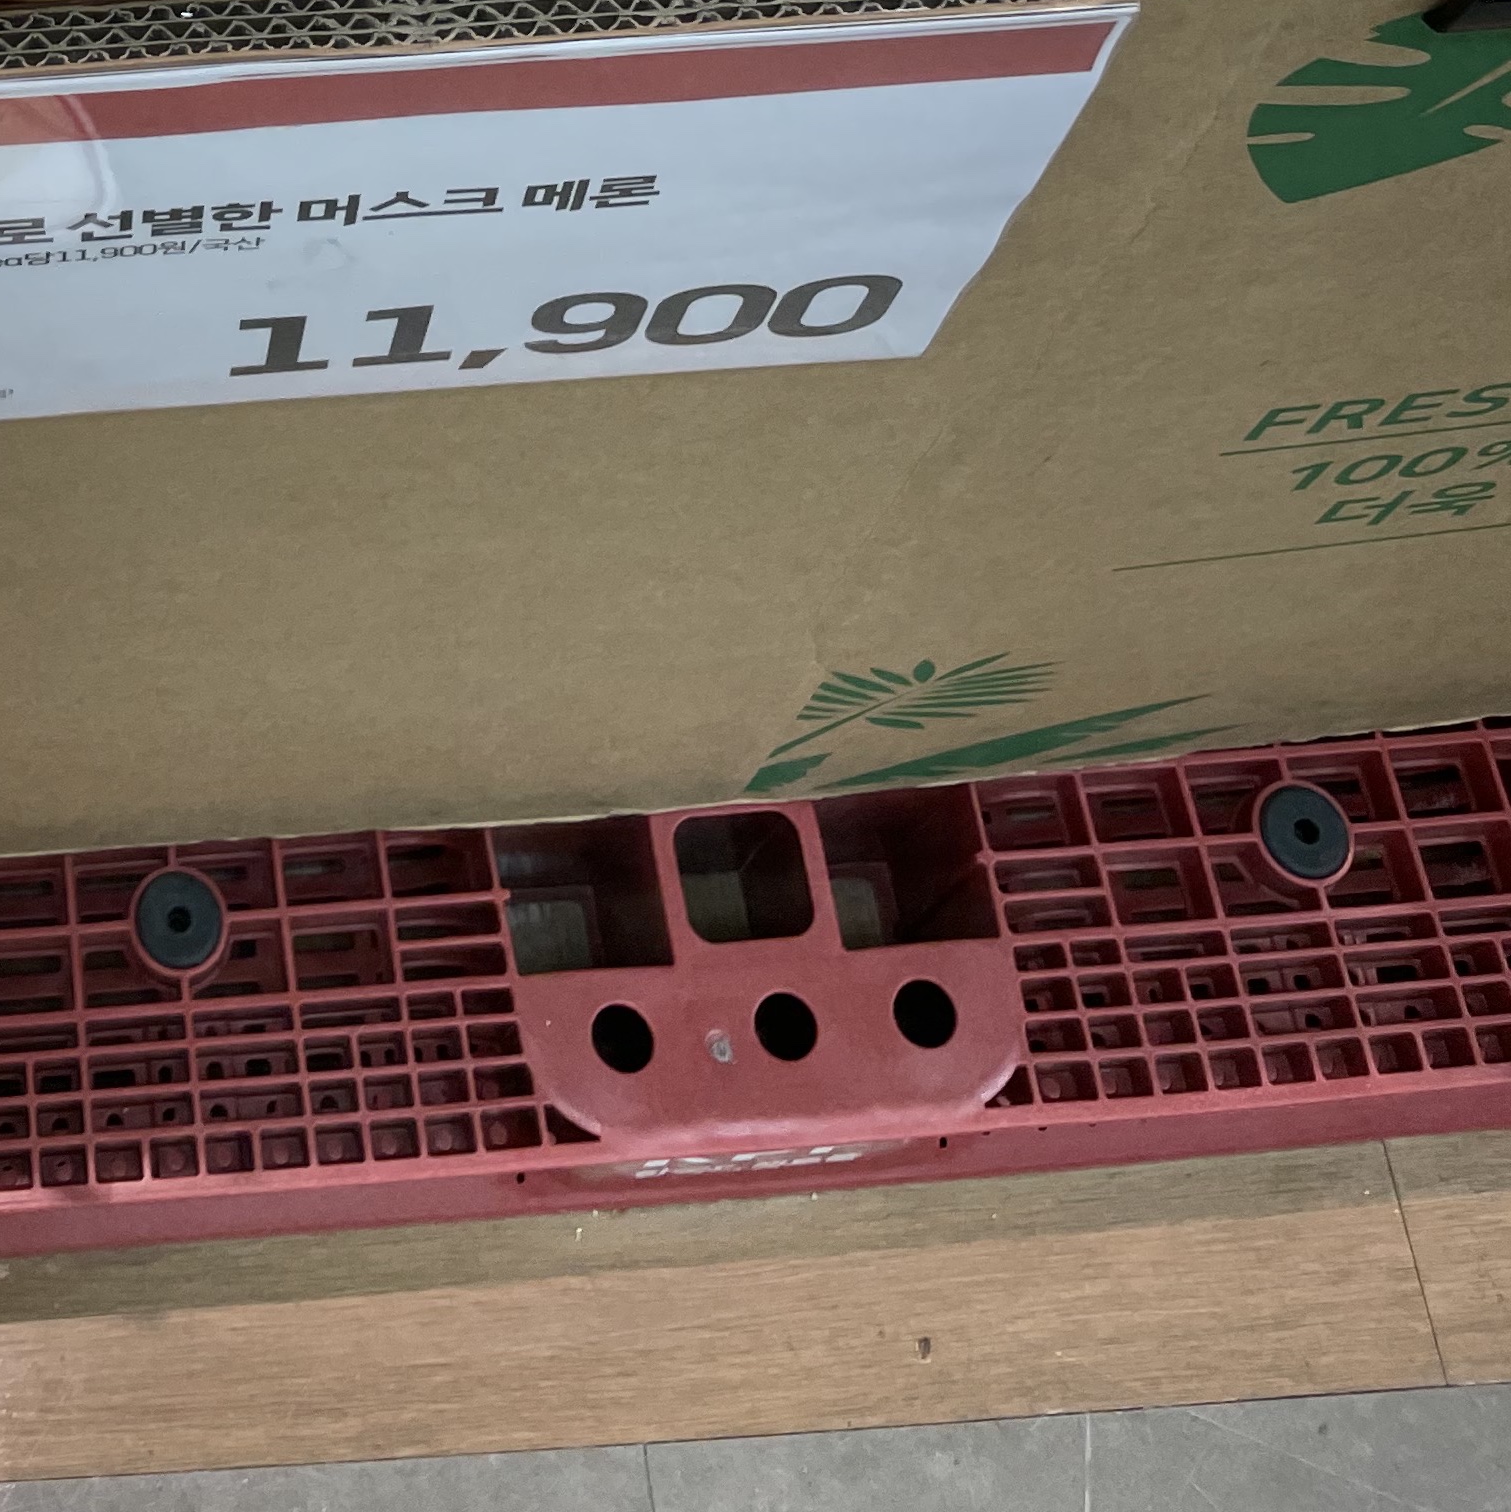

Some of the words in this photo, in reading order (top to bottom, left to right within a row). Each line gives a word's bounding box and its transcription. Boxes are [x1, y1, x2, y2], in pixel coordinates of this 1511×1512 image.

[67, 200, 284, 243] 선별한
[296, 187, 504, 226] 머스크
[521, 173, 660, 212] 메론
[229, 274, 904, 377] 11,900
[1314, 481, 1497, 526] 더욱
